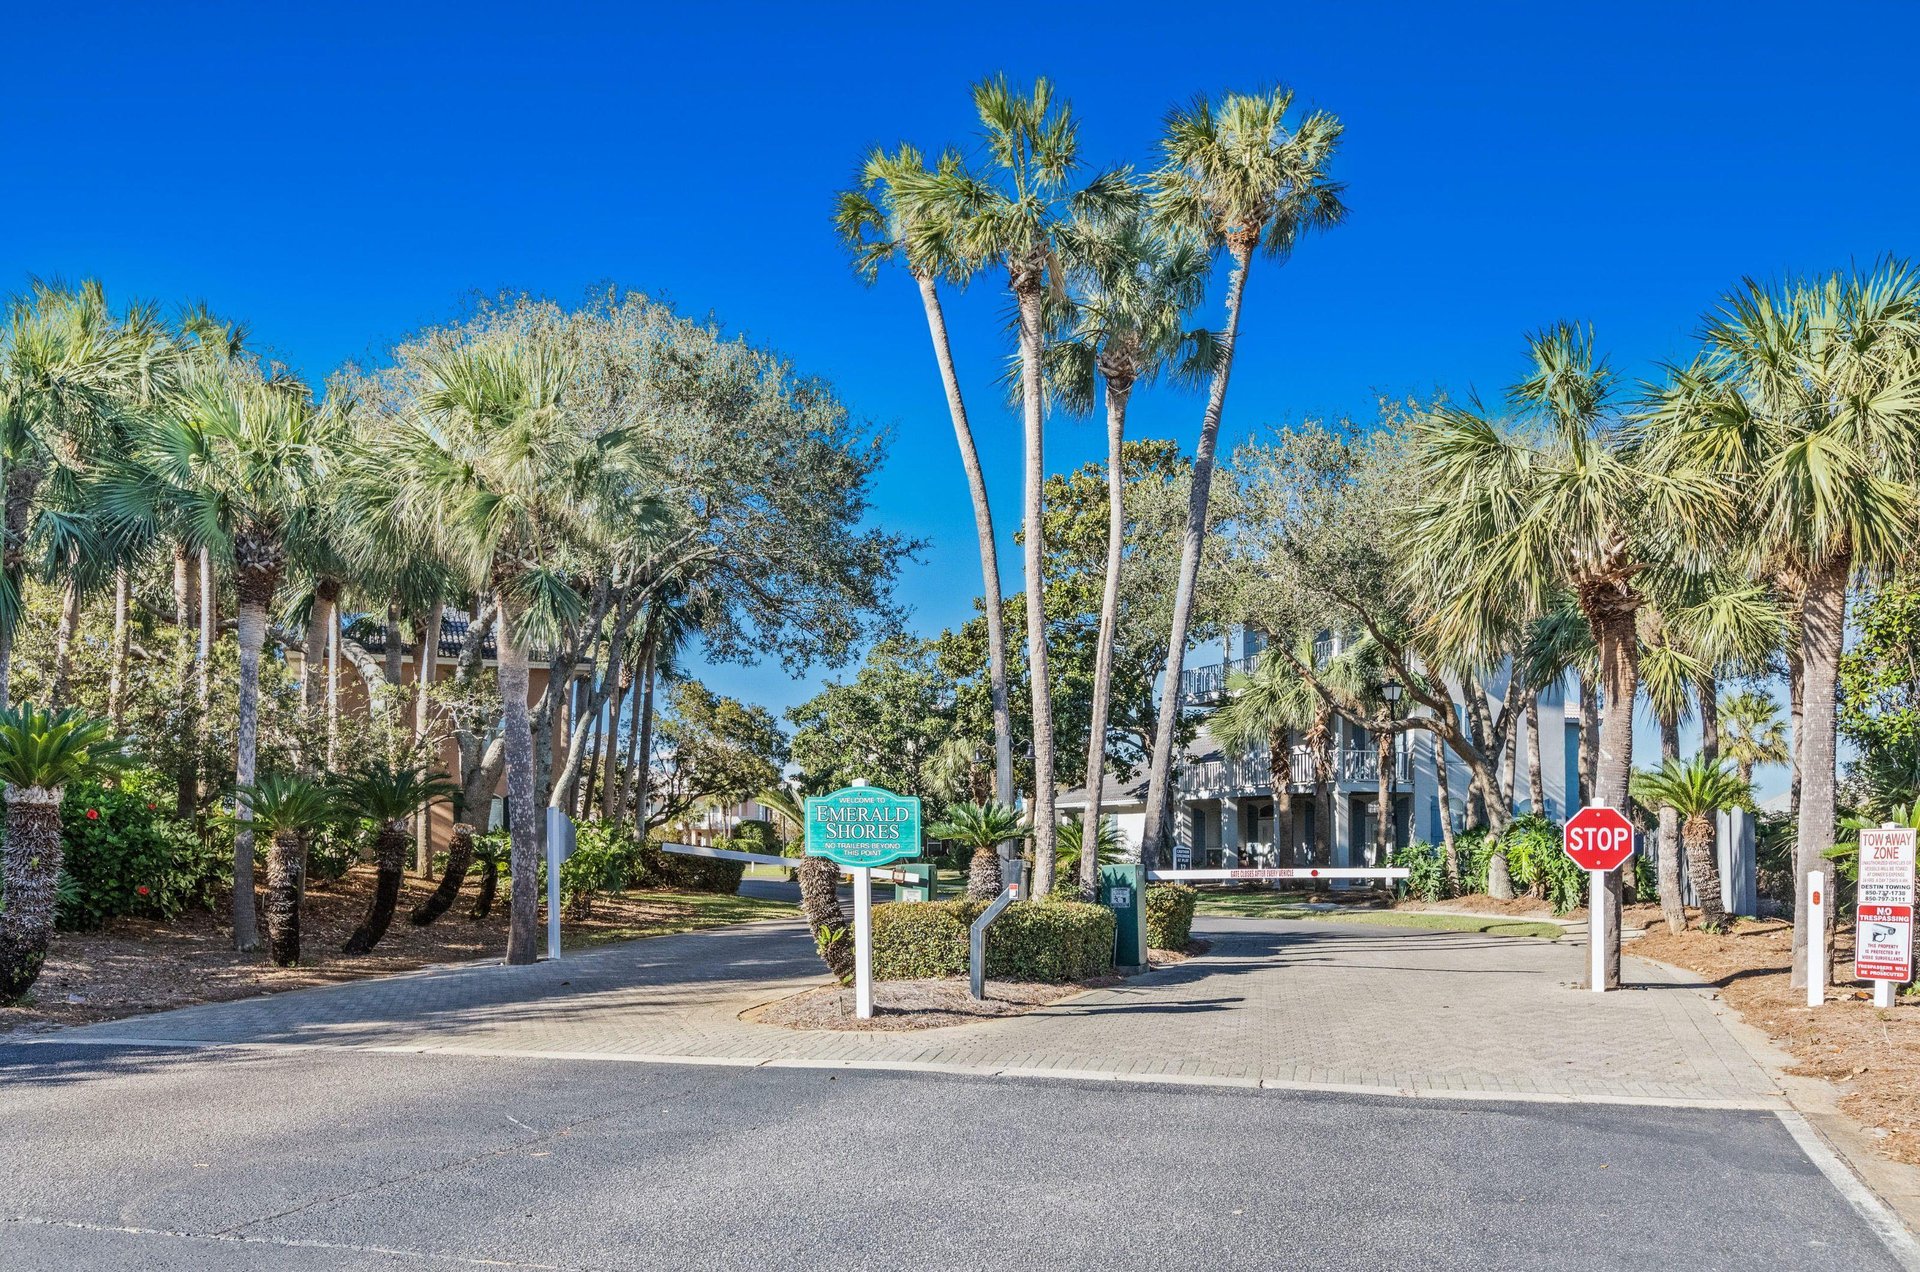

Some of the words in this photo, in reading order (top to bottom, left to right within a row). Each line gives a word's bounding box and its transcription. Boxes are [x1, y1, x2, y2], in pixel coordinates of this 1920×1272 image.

[816, 805, 909, 822] EMERALD
[826, 822, 900, 840] SHORES
[1569, 827, 1629, 851] STOP
[1863, 834, 1884, 846] TOW
[1885, 833, 1912, 846] AWAY
[1874, 847, 1899, 859] ZONE
[1876, 907, 1892, 915] NO
